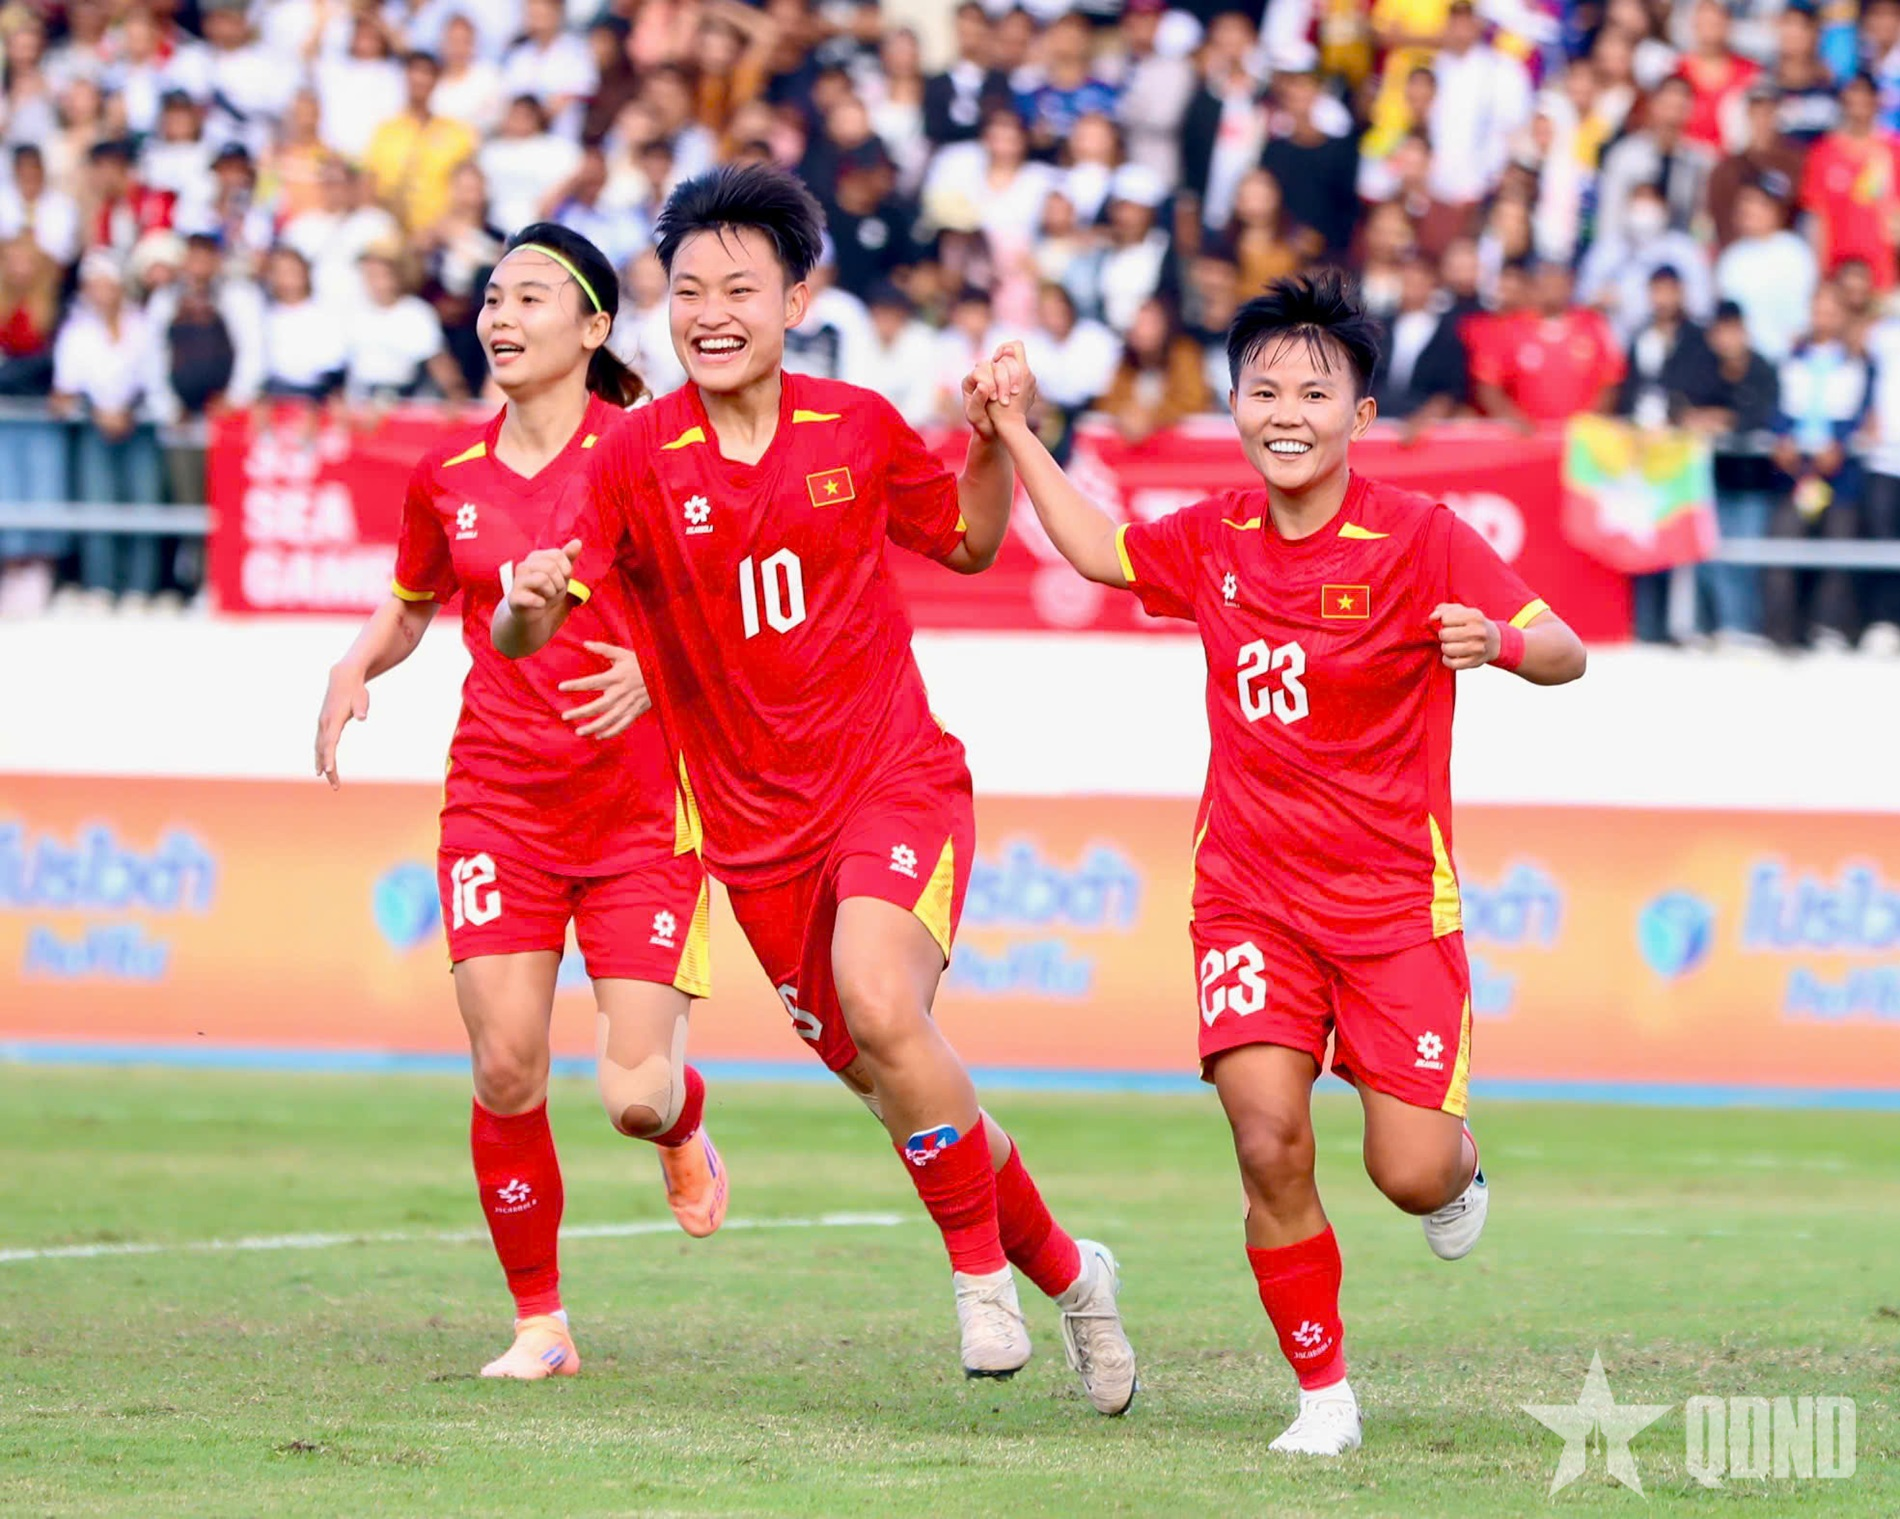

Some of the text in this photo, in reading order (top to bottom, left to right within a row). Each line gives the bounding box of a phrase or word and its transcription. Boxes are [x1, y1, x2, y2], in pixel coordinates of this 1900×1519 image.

[244, 486, 357, 542] SEA
[739, 547, 807, 640] 10
[1237, 637, 1310, 726] 23
[451, 852, 502, 932] 12
[1200, 941, 1266, 1028] 23
